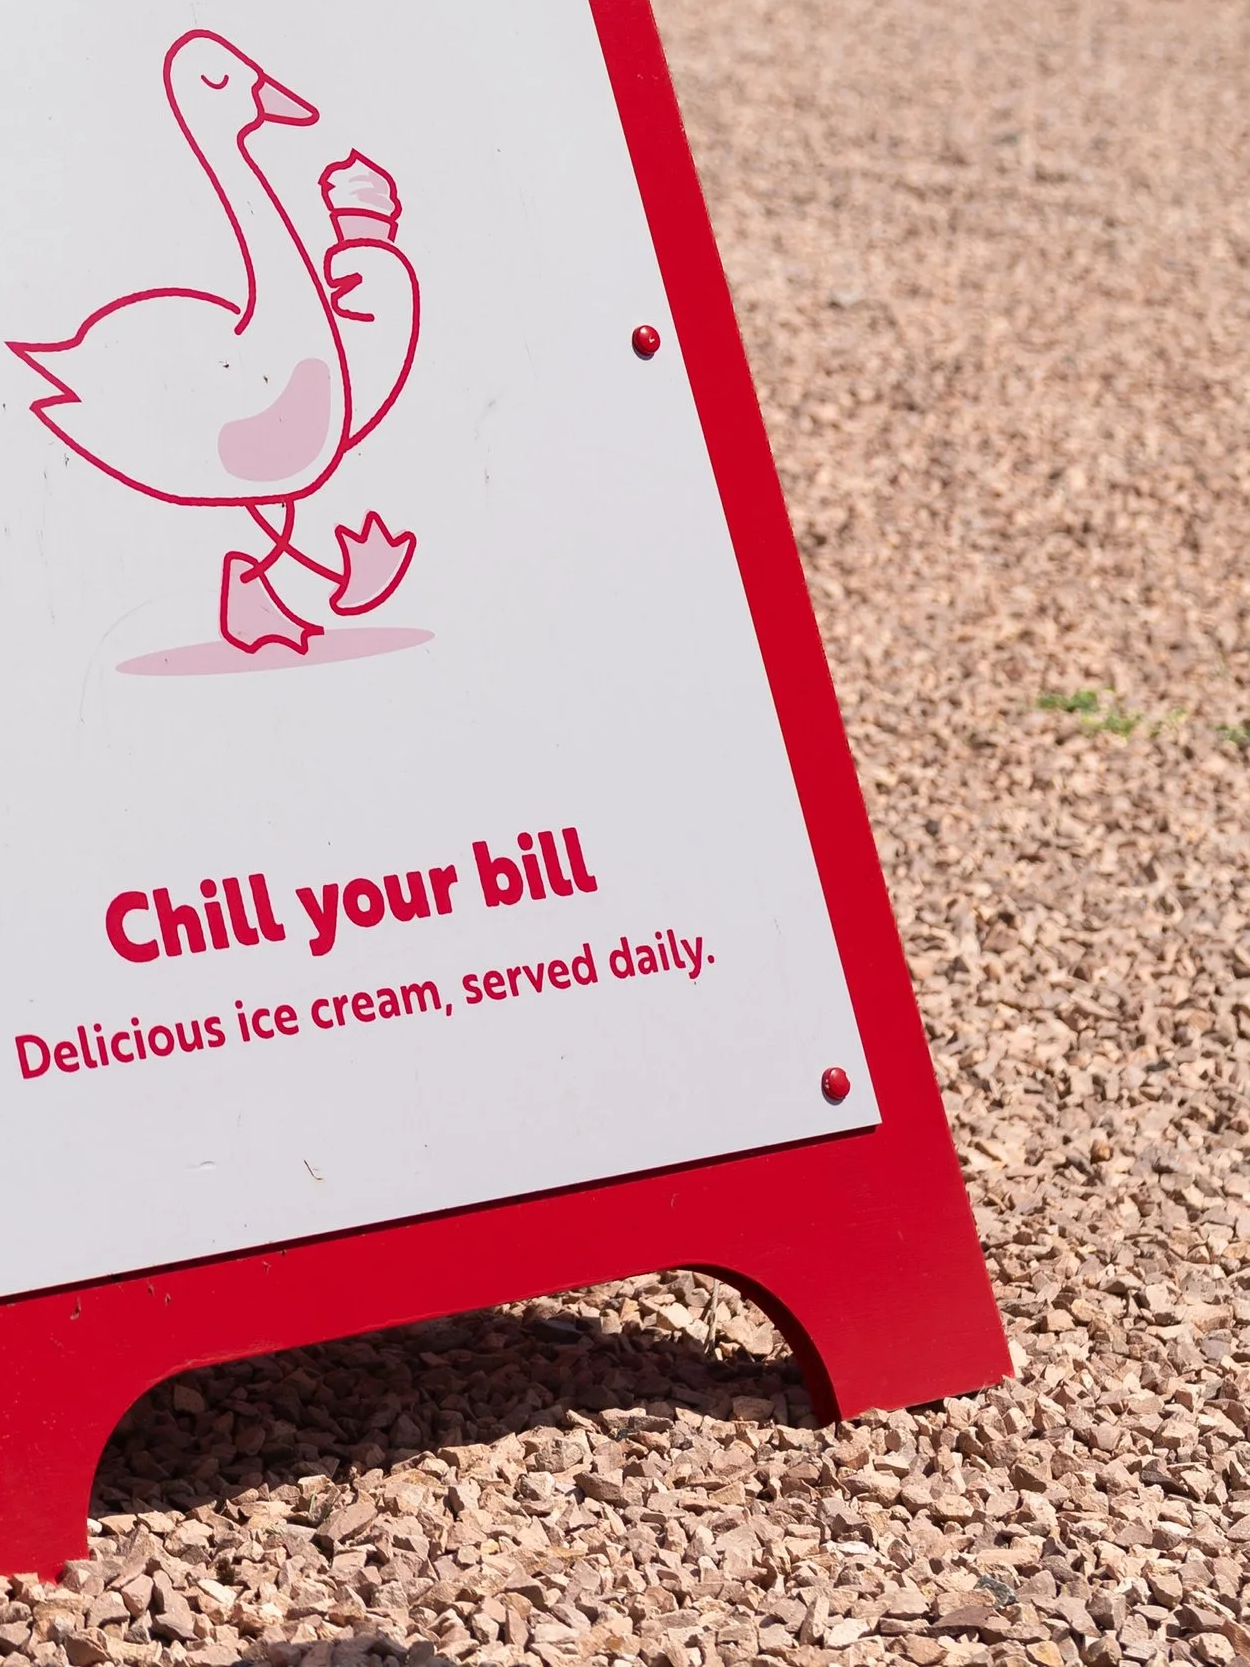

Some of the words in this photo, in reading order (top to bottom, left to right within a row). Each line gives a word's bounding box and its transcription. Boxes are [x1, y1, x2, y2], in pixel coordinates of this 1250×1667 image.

[105, 872, 287, 964] Chill
[295, 864, 459, 957] your
[471, 826, 599, 908] bill
[14, 1015, 226, 1080] Delicious
[236, 999, 300, 1043] ice
[310, 980, 454, 1030] cream,
[461, 942, 599, 1005] served
[608, 928, 716, 980] daily.
